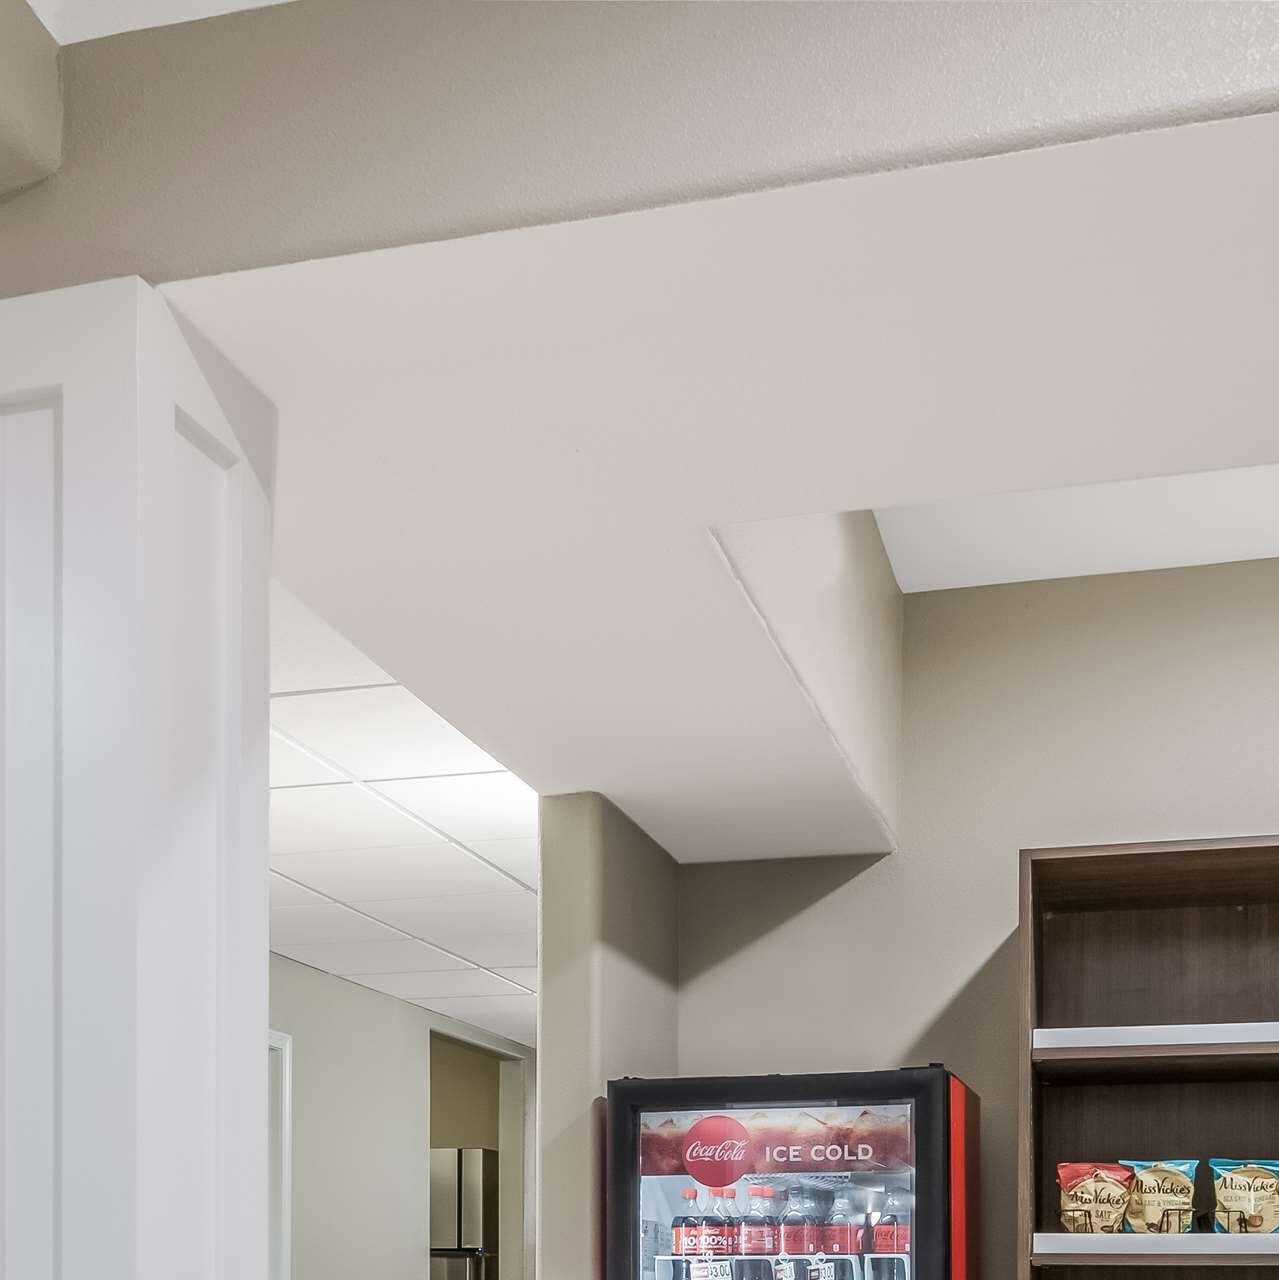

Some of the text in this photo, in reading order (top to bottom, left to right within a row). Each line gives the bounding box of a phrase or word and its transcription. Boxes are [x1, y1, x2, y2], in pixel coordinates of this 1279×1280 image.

[764, 1143, 873, 1162] ICE COLD
[1132, 1176, 1191, 1198] Miss Vickie's
[1219, 1176, 1247, 1192] Miss
[1093, 1187, 1126, 1209] Vickie's
[1095, 1210, 1113, 1219] SALT
